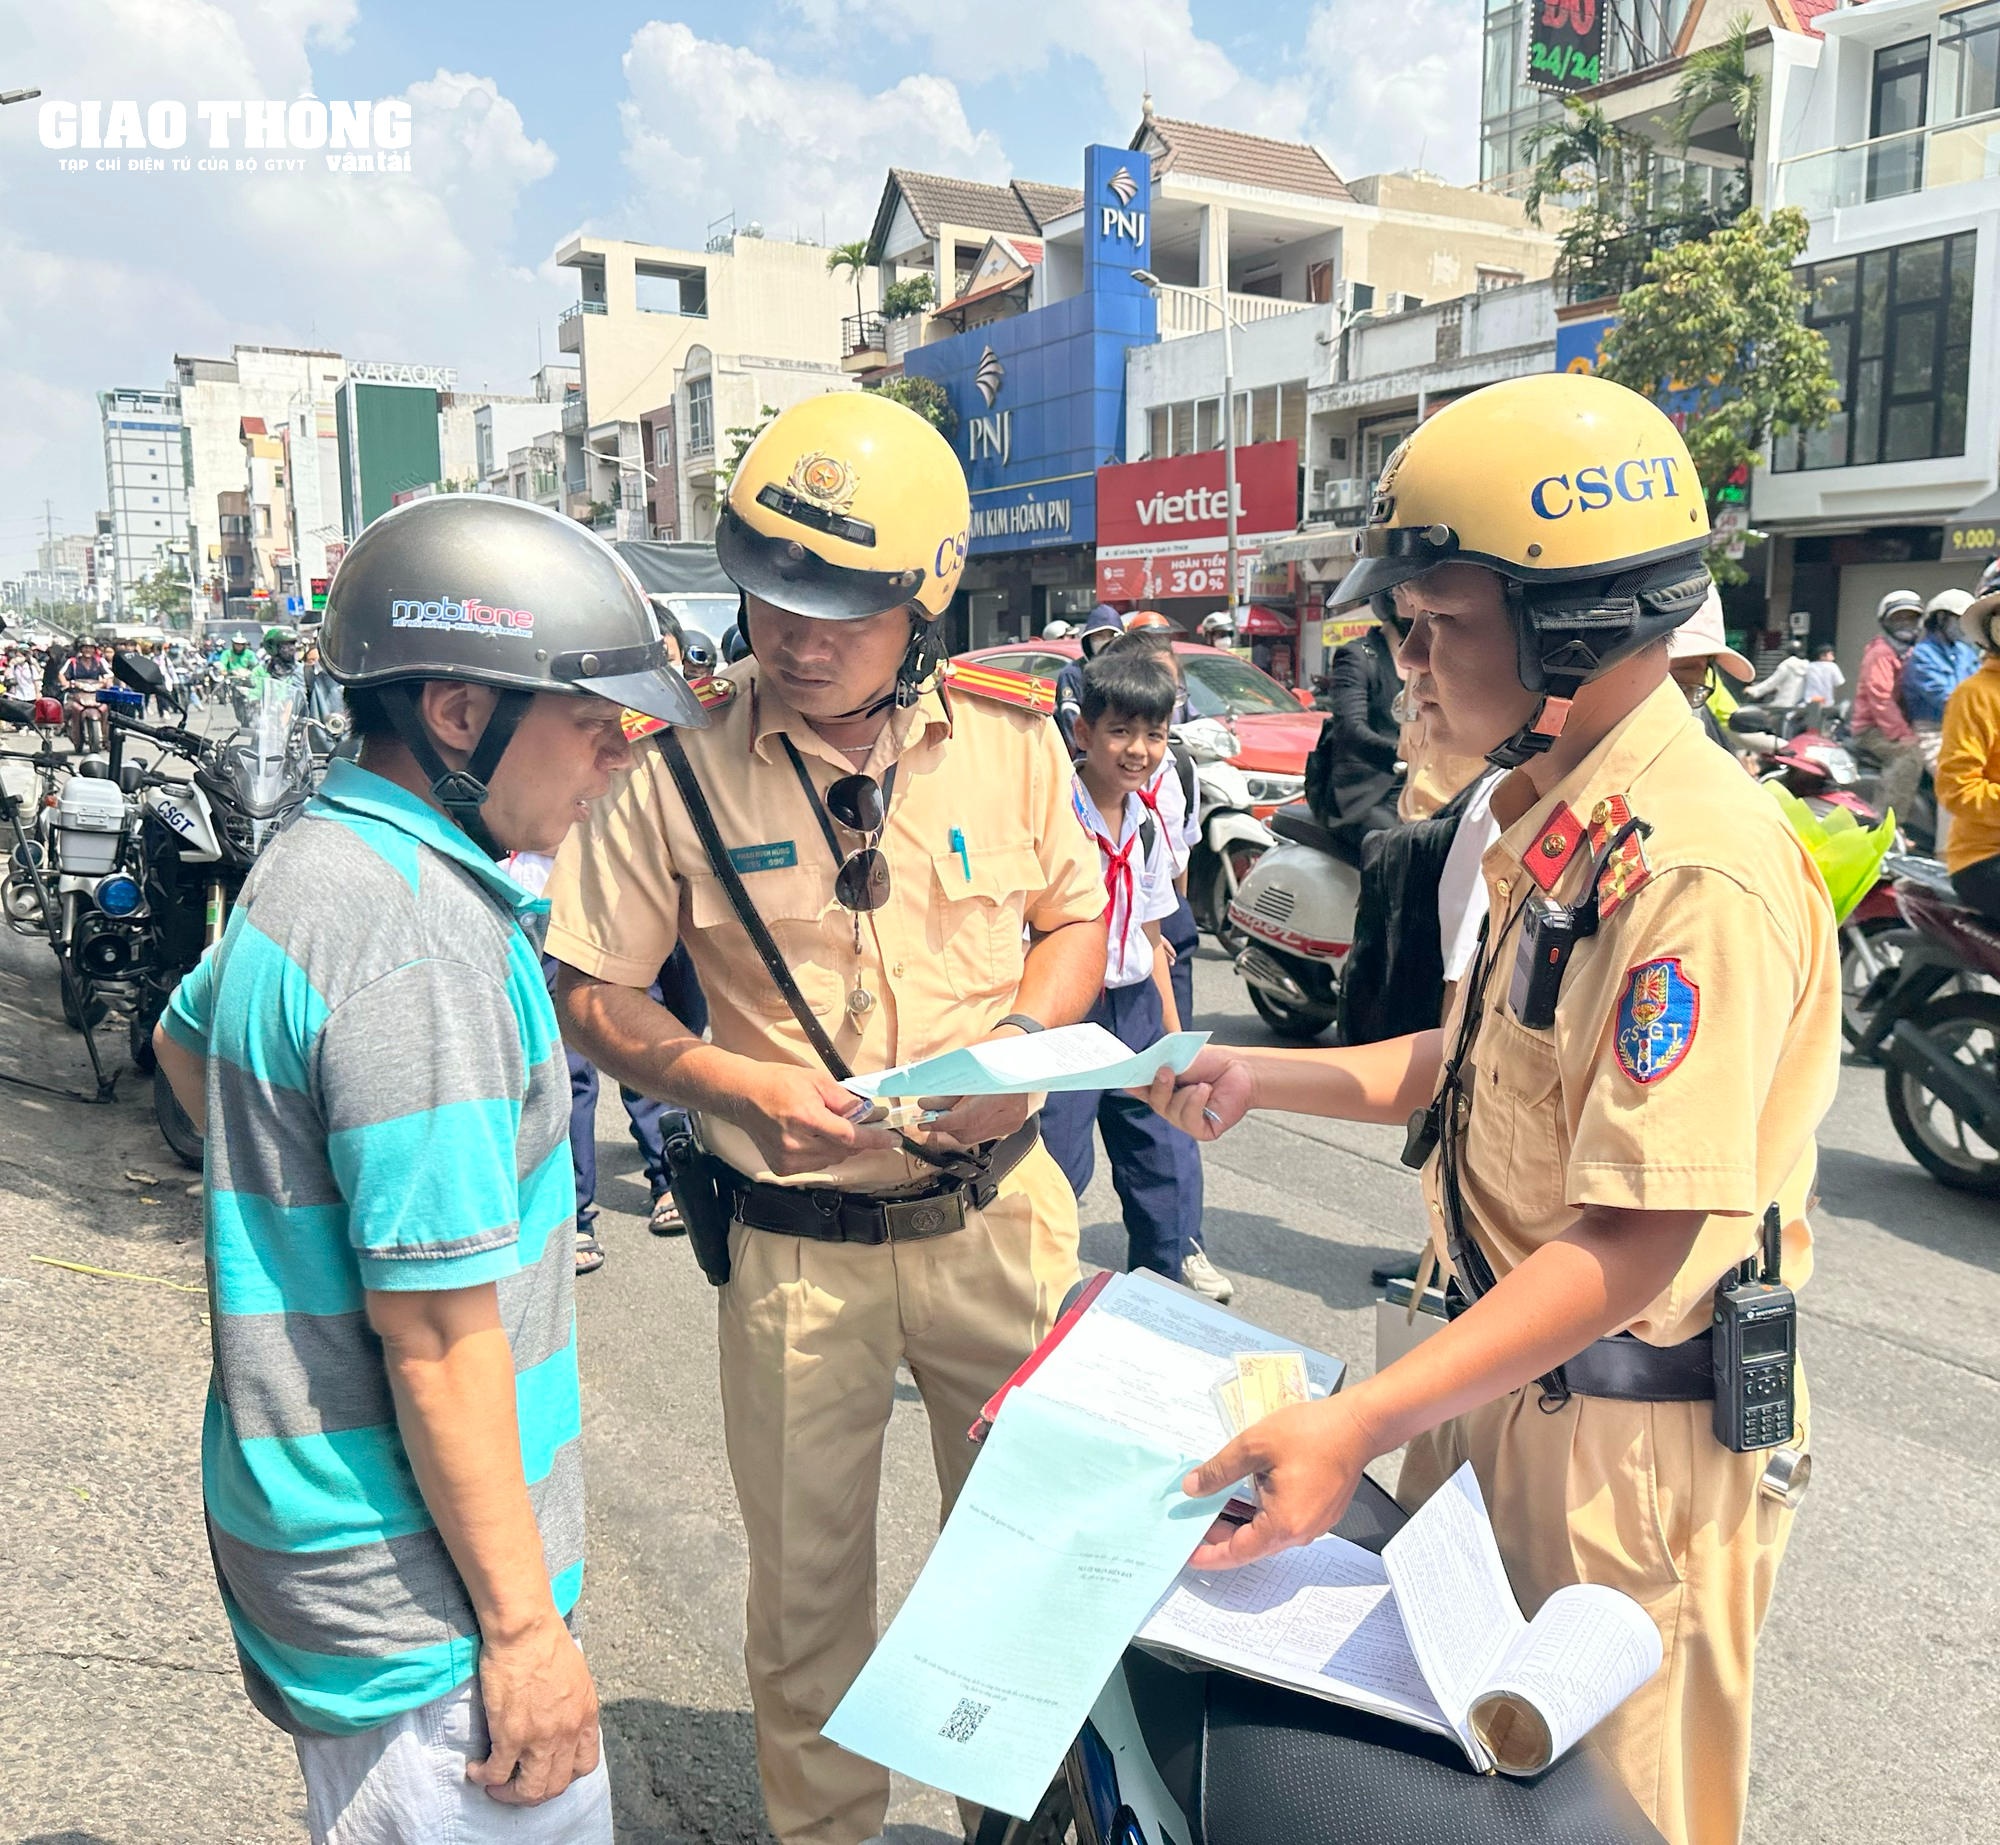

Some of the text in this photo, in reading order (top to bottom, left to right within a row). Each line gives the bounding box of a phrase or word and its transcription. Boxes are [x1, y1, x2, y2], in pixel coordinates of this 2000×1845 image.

[1531, 42, 1600, 85] 24/24
[1102, 207, 1146, 248] PNJ
[347, 361, 459, 386] KARAOKE
[969, 410, 1011, 467] PNJ
[1135, 482, 1248, 527] viettel
[1532, 456, 1680, 520] CSGT
[987, 507, 1008, 536] KIM
[1010, 493, 1045, 533] HOÀN
[1048, 499, 1071, 534] PNJ
[935, 530, 969, 579] CS
[1171, 556, 1200, 570] HOÀN
[392, 596, 535, 629] mobifone
[157, 800, 195, 833] CSGT
[1620, 1022, 1683, 1044] CSGT
[1755, 1305, 1788, 1317] MOTOROLA
